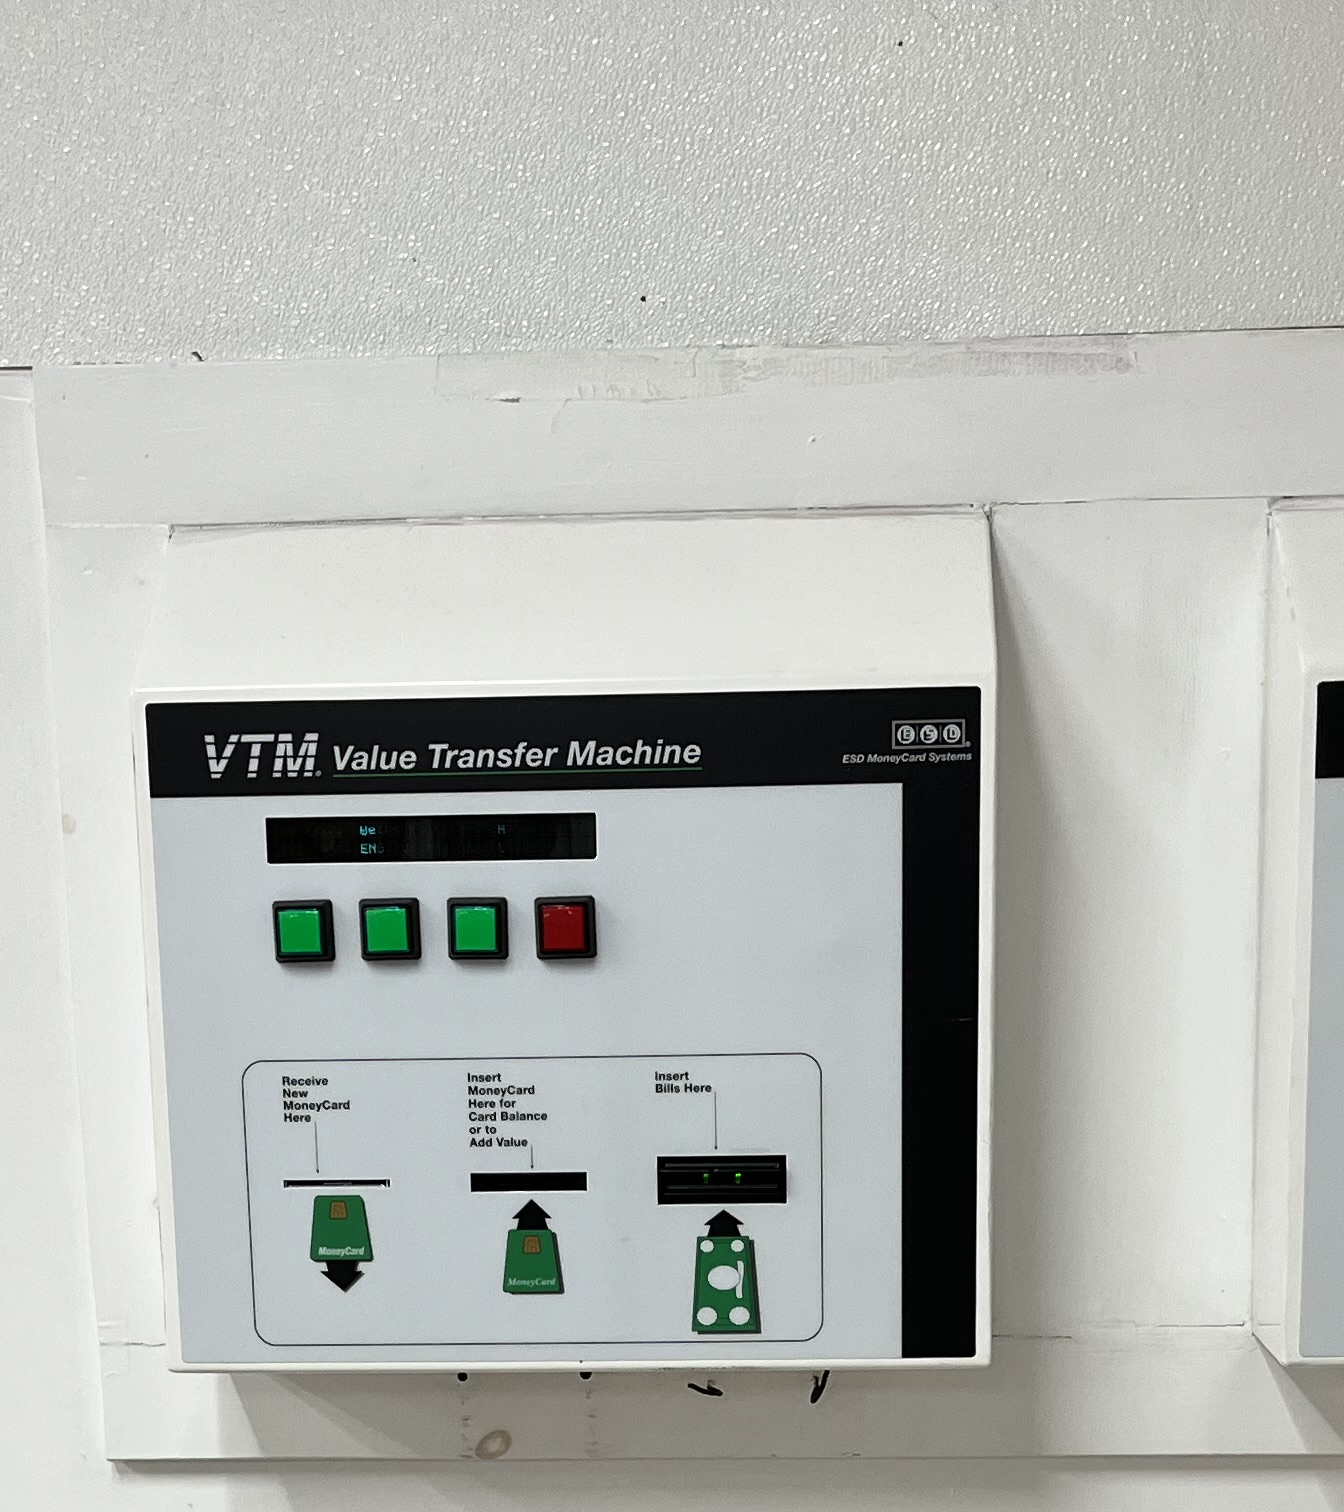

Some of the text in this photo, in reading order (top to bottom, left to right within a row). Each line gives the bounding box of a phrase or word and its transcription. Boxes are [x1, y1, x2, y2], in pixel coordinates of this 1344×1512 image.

[204, 732, 319, 779] VTM
[333, 739, 702, 771] Value Transfer Machine
[842, 752, 973, 765] ESD MoneyCard Systems
[282, 1076, 329, 1086] Receive
[467, 1072, 502, 1082] Insert
[654, 1071, 689, 1081] Insert
[282, 1088, 308, 1098] New
[467, 1085, 535, 1097] MoneyCard
[655, 1083, 712, 1093] Bills Here
[283, 1100, 350, 1112] MoneyCard
[468, 1098, 517, 1108] Here for
[283, 1113, 311, 1123] Here
[468, 1111, 548, 1121] Card Balance
[469, 1125, 497, 1134] or to
[469, 1137, 528, 1147] Add Value
[317, 1246, 365, 1257] MoneyCard
[507, 1277, 557, 1288] MoneyCard
